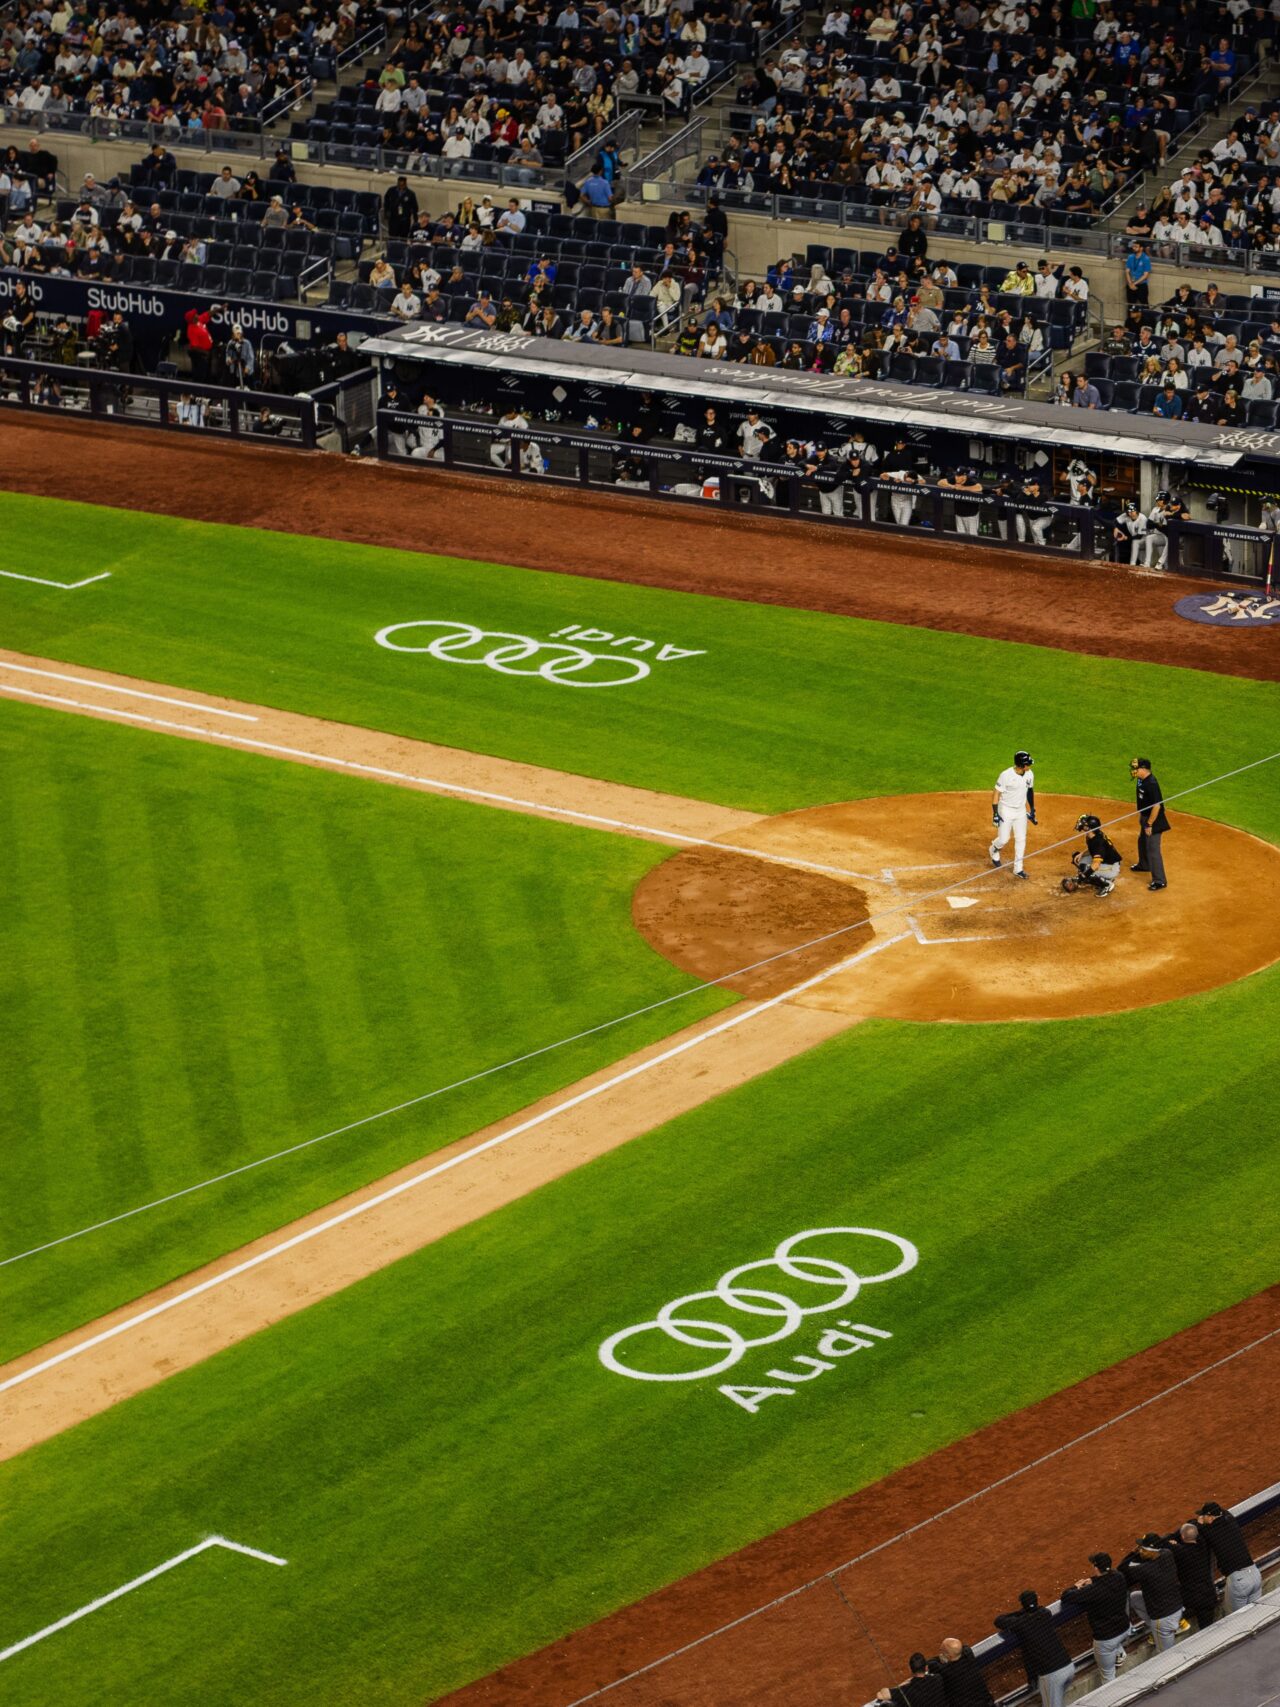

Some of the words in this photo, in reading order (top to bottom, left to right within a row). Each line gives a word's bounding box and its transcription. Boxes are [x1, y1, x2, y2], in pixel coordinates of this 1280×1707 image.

[88, 287, 164, 316] StubHub
[211, 303, 288, 332] StubHub
[549, 624, 707, 660] Audi
[717, 1320, 893, 1413] Audi
